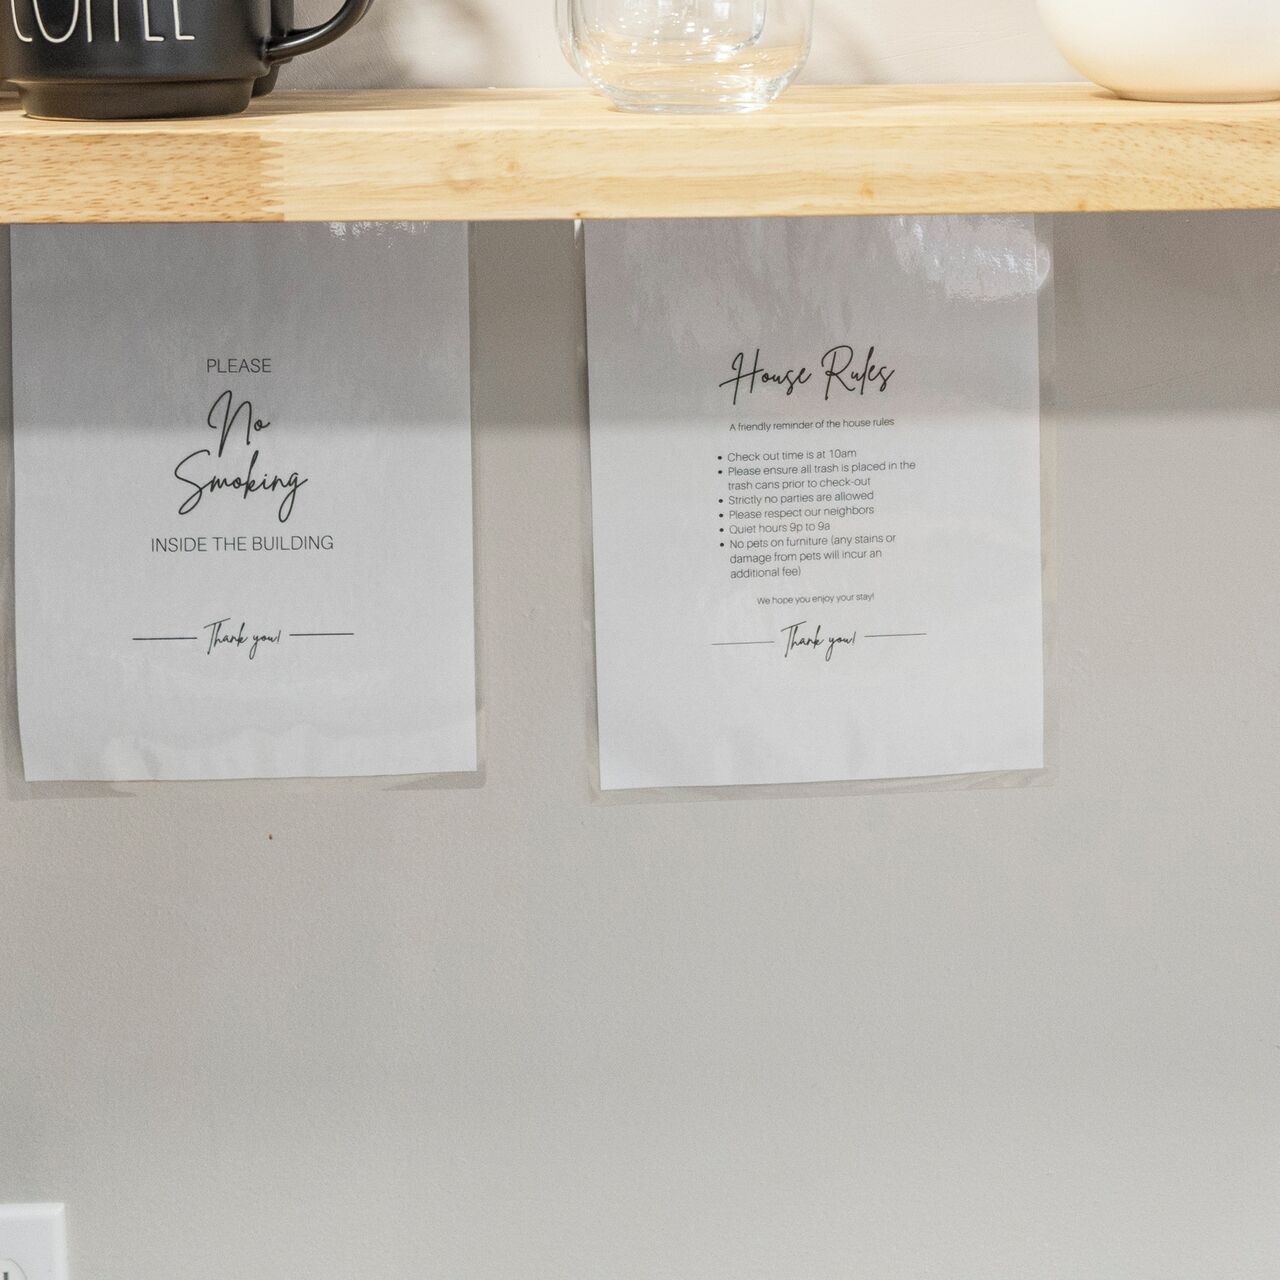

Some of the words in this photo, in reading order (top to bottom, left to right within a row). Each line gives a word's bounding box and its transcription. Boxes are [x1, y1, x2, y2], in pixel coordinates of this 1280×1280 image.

[207, 358, 272, 373] PLEASE
[719, 348, 812, 405] House
[821, 345, 895, 401] Rules
[208, 390, 271, 458] No
[738, 422, 770, 432] friendly
[773, 422, 813, 430] reminder
[815, 421, 825, 429] of
[826, 420, 840, 428] the
[843, 419, 870, 427] house
[873, 418, 894, 426] rules
[728, 452, 760, 462] Check
[763, 452, 780, 461] out
[782, 451, 803, 460] time
[806, 451, 814, 459] is
[817, 451, 825, 459] at
[830, 449, 856, 458] 10am
[728, 467, 761, 476] Please
[763, 466, 798, 475] ensure
[801, 464, 812, 473] all
[814, 463, 838, 473] trash
[841, 463, 849, 472] is
[852, 462, 886, 474] placed
[889, 461, 897, 470] in
[900, 461, 916, 470] the
[175, 449, 308, 523] Smoking
[728, 481, 752, 491] trash
[755, 481, 779, 490] cans
[782, 479, 805, 491] prior
[807, 479, 817, 488] to
[820, 478, 870, 487] check-out
[729, 495, 762, 507] Strictly
[765, 496, 777, 504] no
[781, 493, 814, 505] parties
[816, 493, 832, 502] are
[835, 491, 874, 501] allowed
[729, 510, 762, 520] Please
[765, 508, 802, 520] respect
[804, 508, 821, 516] our
[824, 506, 874, 517] neighbors
[729, 524, 756, 534] Quiet
[759, 523, 787, 533] hours
[790, 522, 803, 533] 9p
[806, 523, 815, 531] to
[817, 522, 830, 530] 9a
[151, 537, 207, 552] INSIDE
[212, 537, 247, 551] THE
[252, 536, 334, 550] BUILDING
[730, 539, 744, 549] No
[747, 538, 768, 550] pets
[771, 538, 784, 547] on
[786, 536, 828, 546] furniture
[831, 535, 851, 546] (any
[854, 534, 883, 544] stains
[886, 534, 896, 542] or
[730, 553, 771, 566] damage
[774, 552, 797, 562] from
[799, 552, 821, 563] pets
[823, 551, 839, 559] will
[842, 550, 867, 559] incur
[869, 550, 882, 558] an
[730, 568, 779, 579] additional
[782, 566, 801, 577] fee)
[757, 597, 770, 605] We
[772, 596, 793, 605] hope
[795, 596, 811, 605] you
[812, 595, 834, 605] enjoy
[836, 594, 854, 603] your
[856, 593, 874, 602] stay!
[204, 618, 248, 655] Thank
[248, 630, 281, 660] you!
[781, 621, 824, 657] Thank
[825, 632, 856, 662] you!
